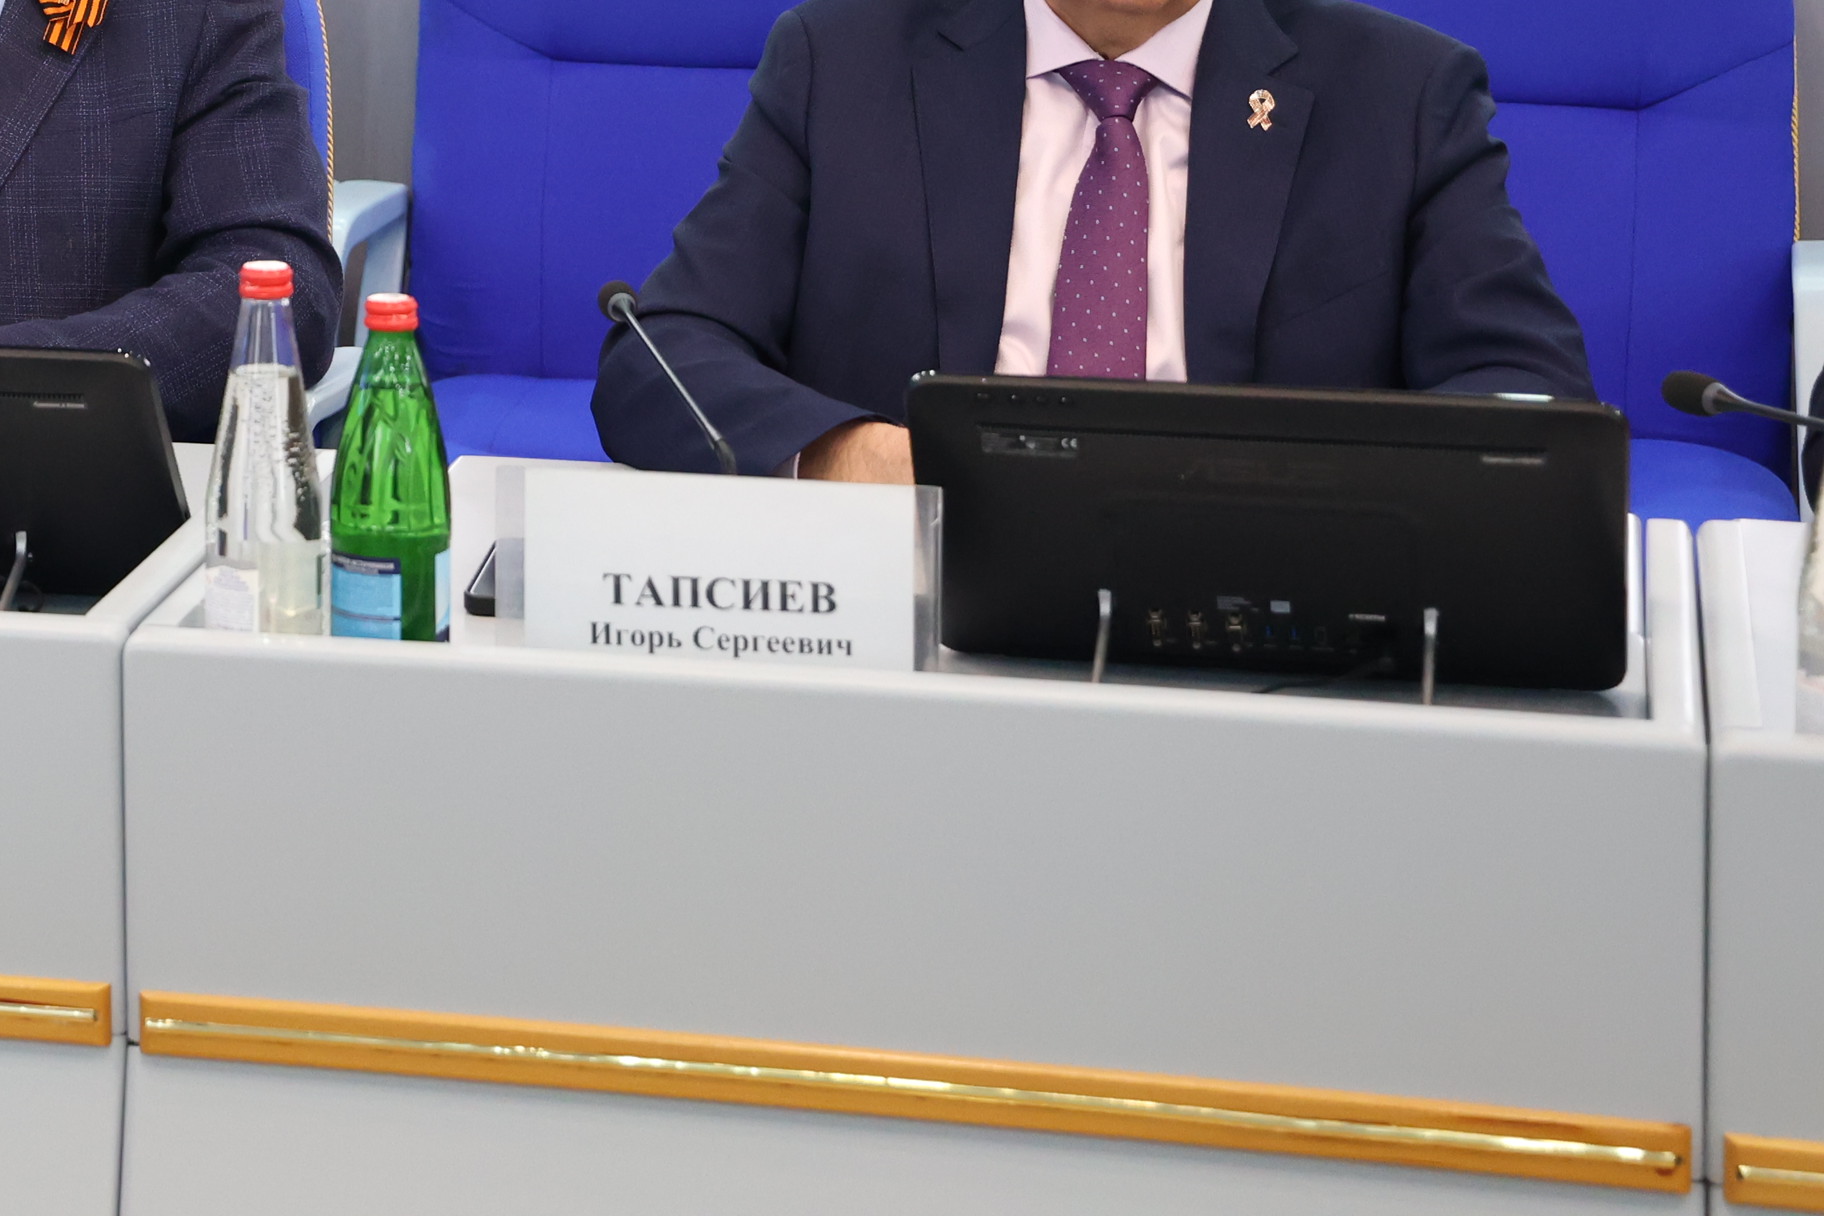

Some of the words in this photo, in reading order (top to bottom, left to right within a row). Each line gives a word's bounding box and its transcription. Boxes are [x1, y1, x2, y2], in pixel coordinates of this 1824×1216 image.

[602, 572, 838, 614] ТАПСИЕВ
[590, 621, 682, 654] Игорь
[692, 625, 853, 658] Сергеевич
